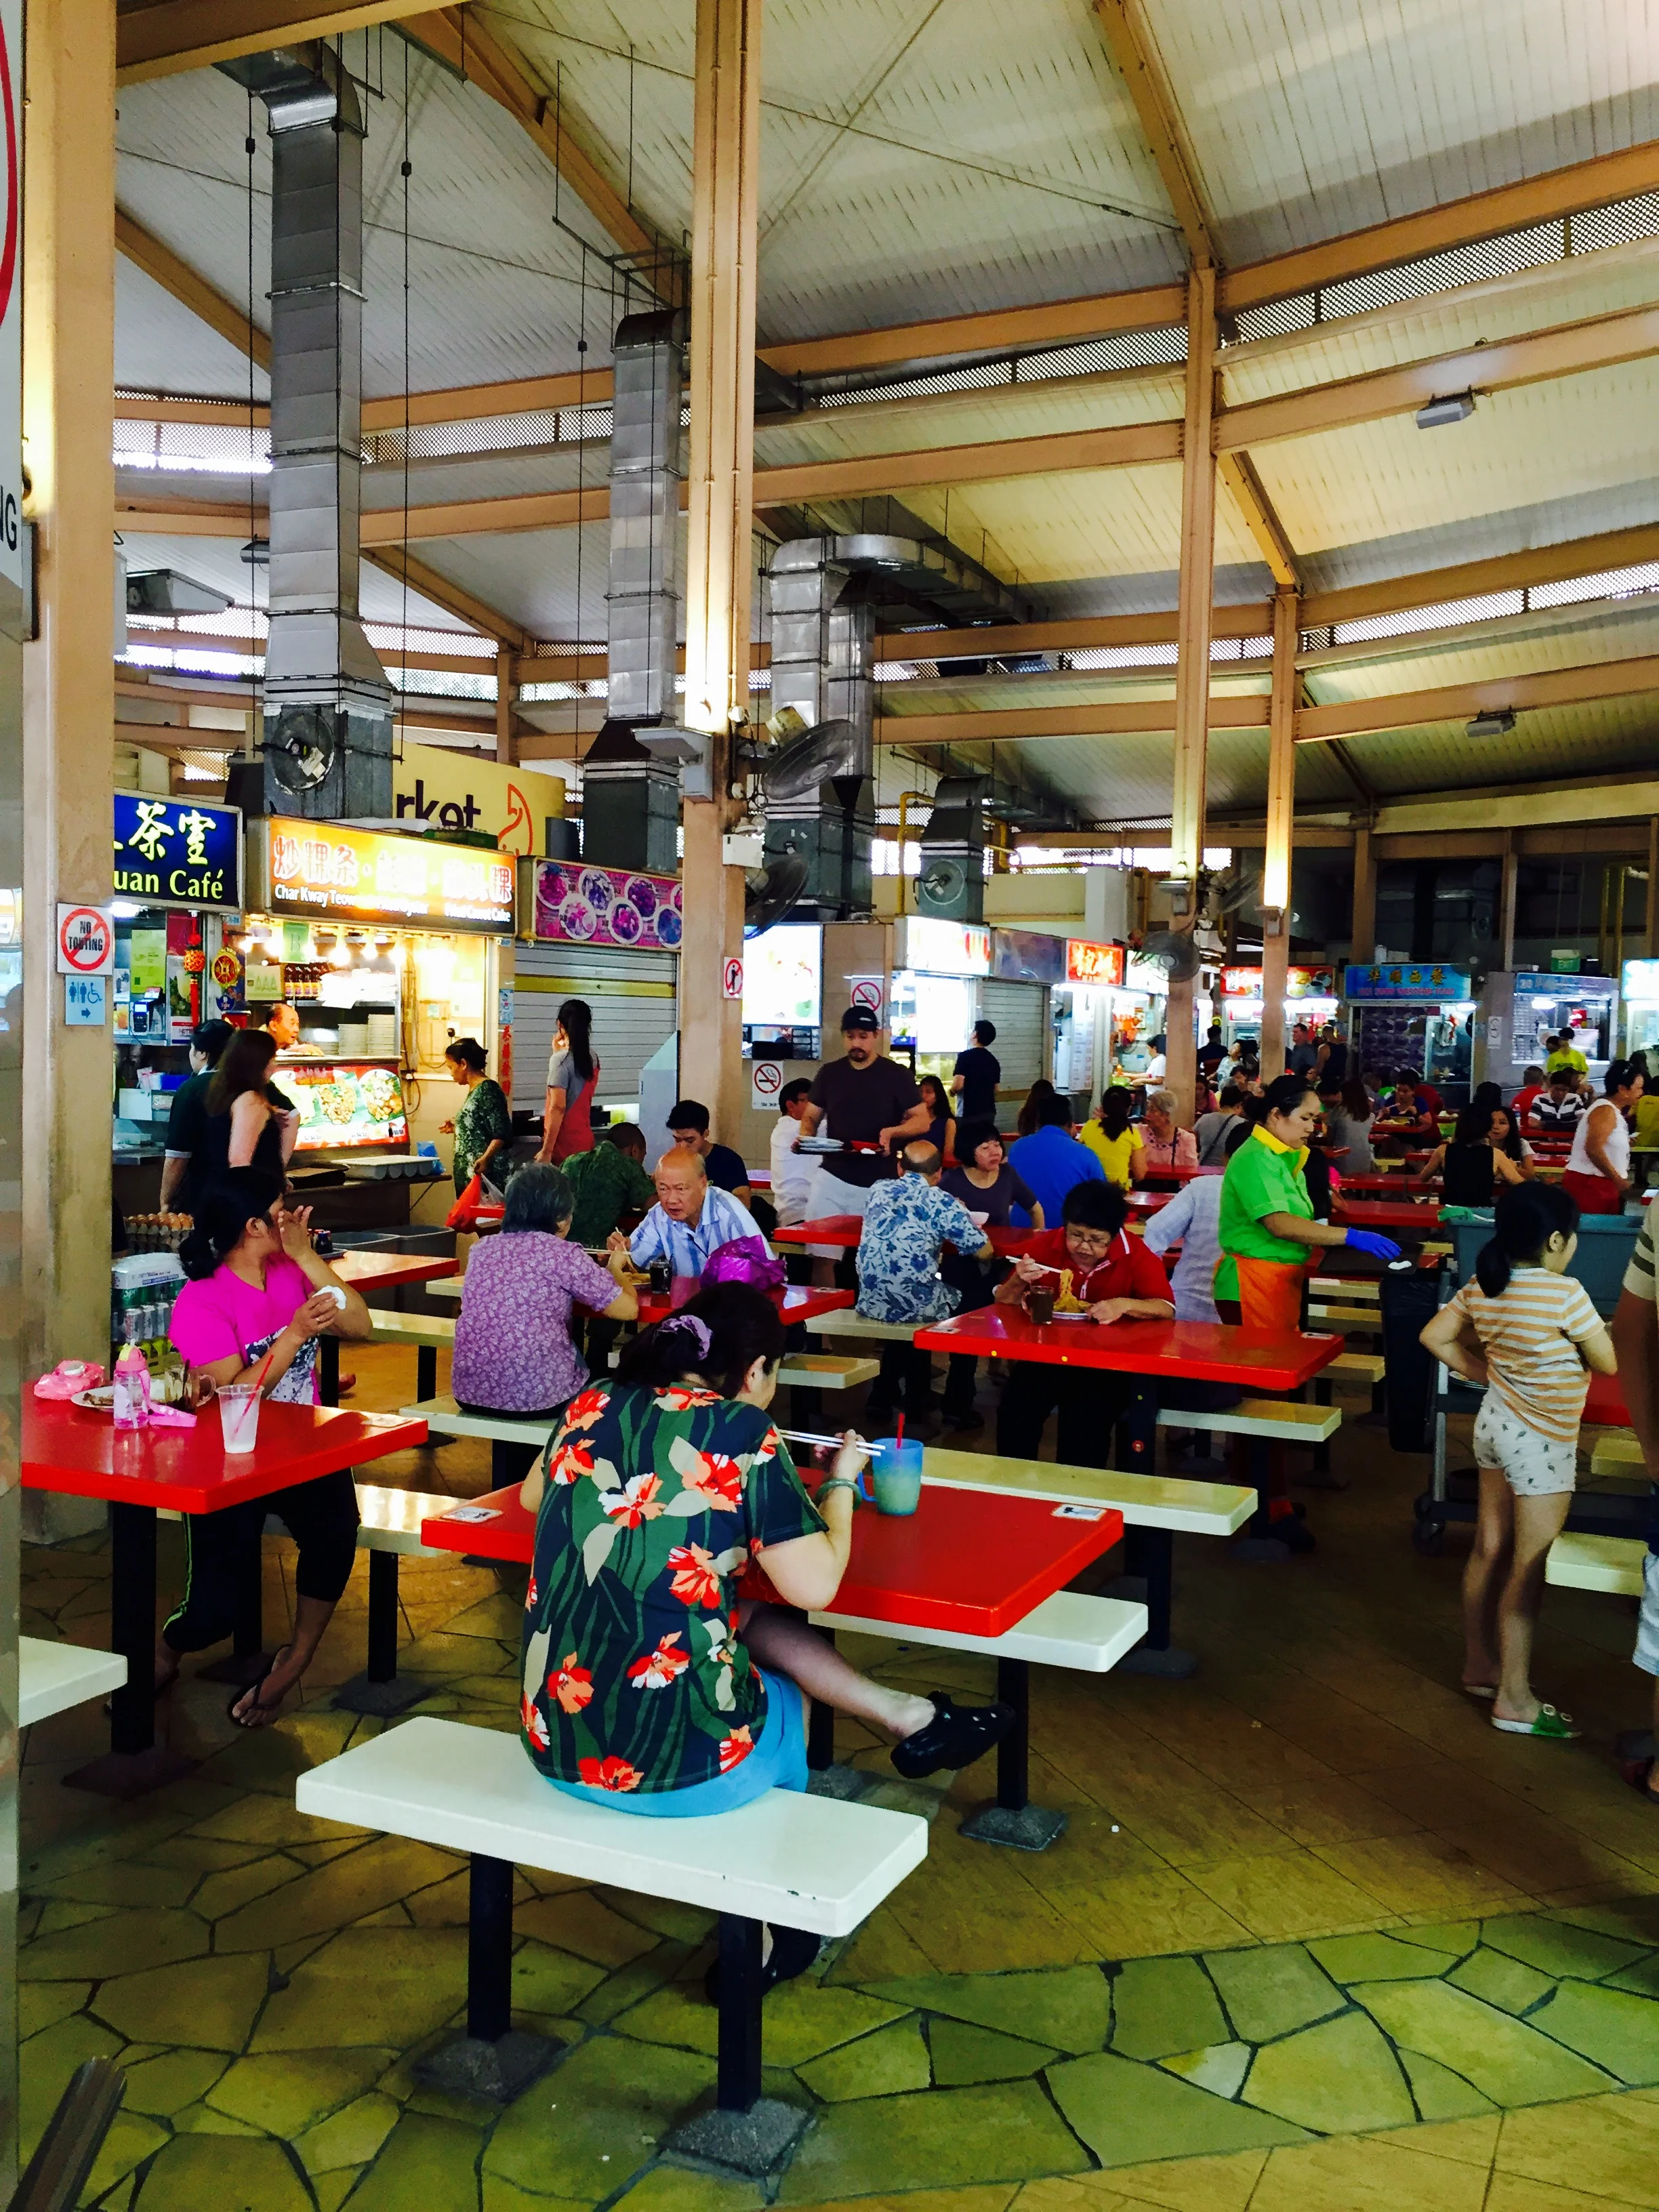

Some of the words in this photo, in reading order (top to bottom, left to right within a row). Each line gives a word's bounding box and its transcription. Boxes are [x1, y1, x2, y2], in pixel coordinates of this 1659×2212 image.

[113, 800, 217, 866] 茶室
[169, 869, 224, 900] Café
[274, 883, 300, 901] Char
[300, 886, 329, 908] Kway
[79, 920, 91, 935] NO
[68, 936, 103, 951] TOUTING
[290, 933, 301, 951] B
